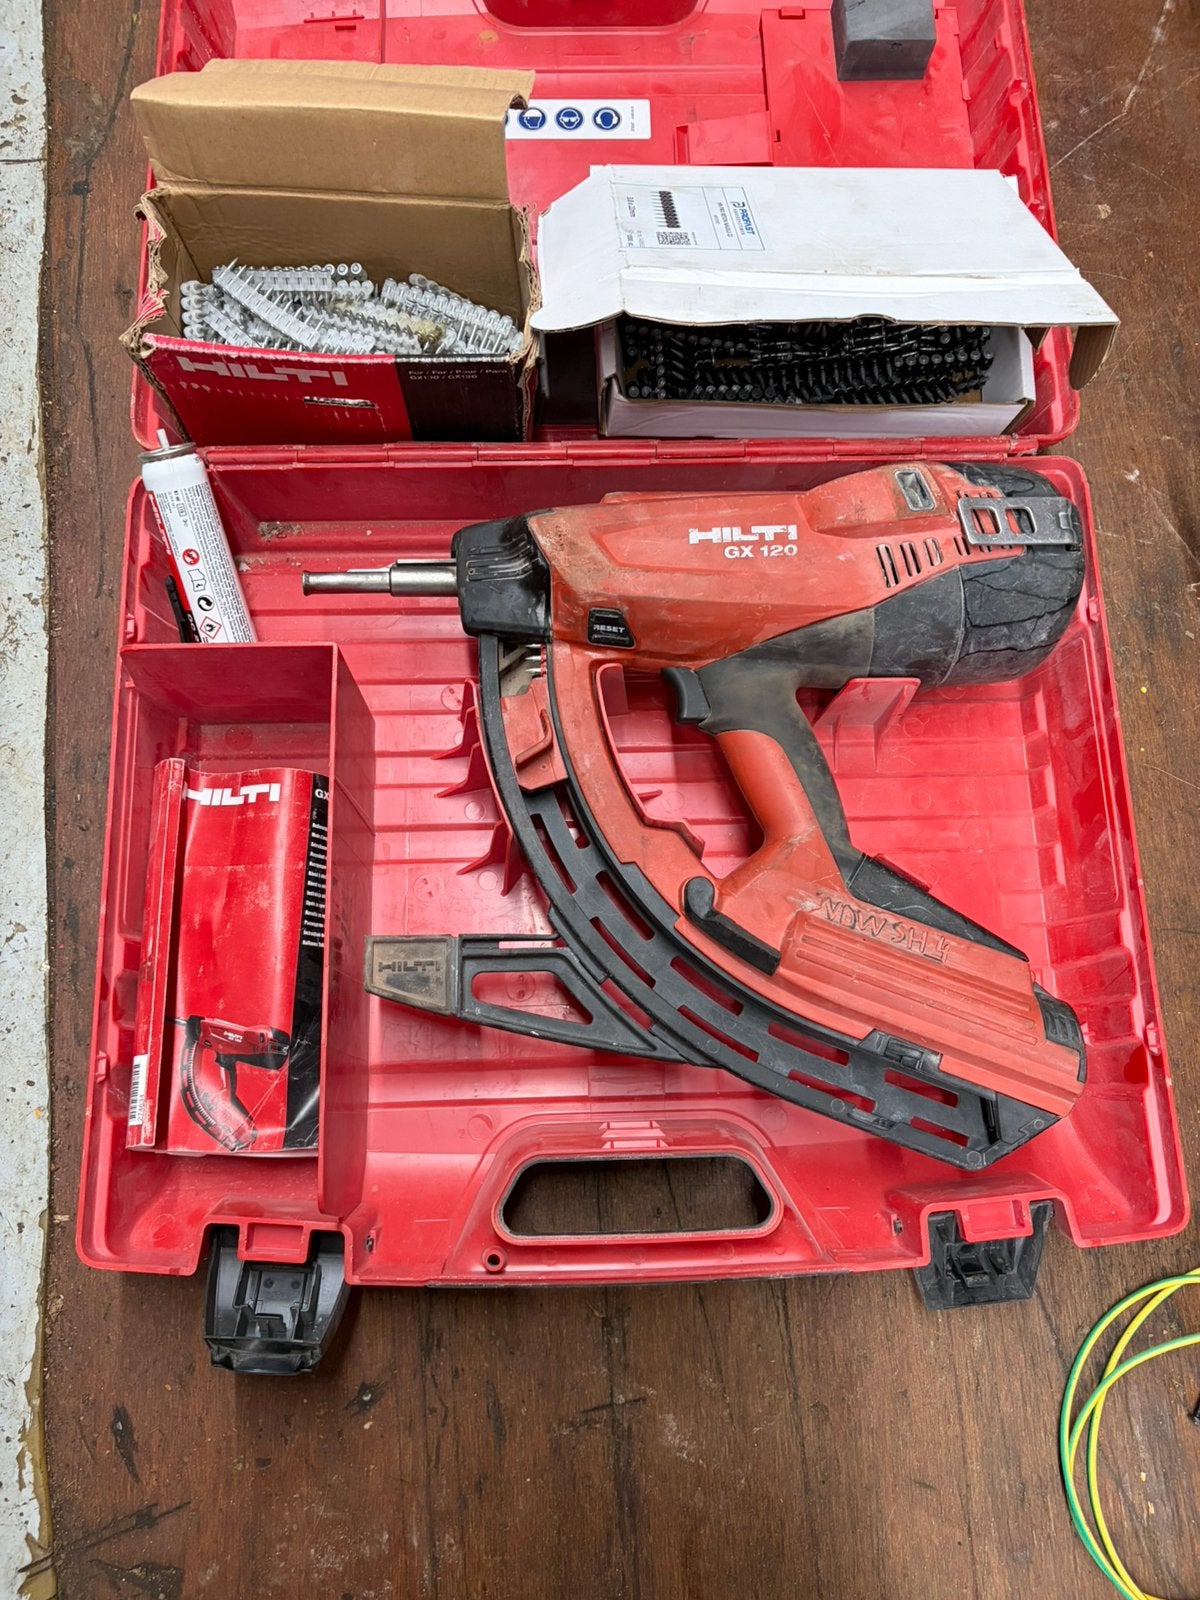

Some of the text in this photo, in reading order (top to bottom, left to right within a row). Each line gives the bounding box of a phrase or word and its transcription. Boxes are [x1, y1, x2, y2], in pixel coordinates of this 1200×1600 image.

[176, 356, 348, 386] HILTI
[688, 525, 798, 544] HILTI
[724, 544, 798, 559] GX 120
[593, 624, 625, 634] RESET
[182, 781, 281, 806] HILTI
[378, 960, 441, 973] HILTI
